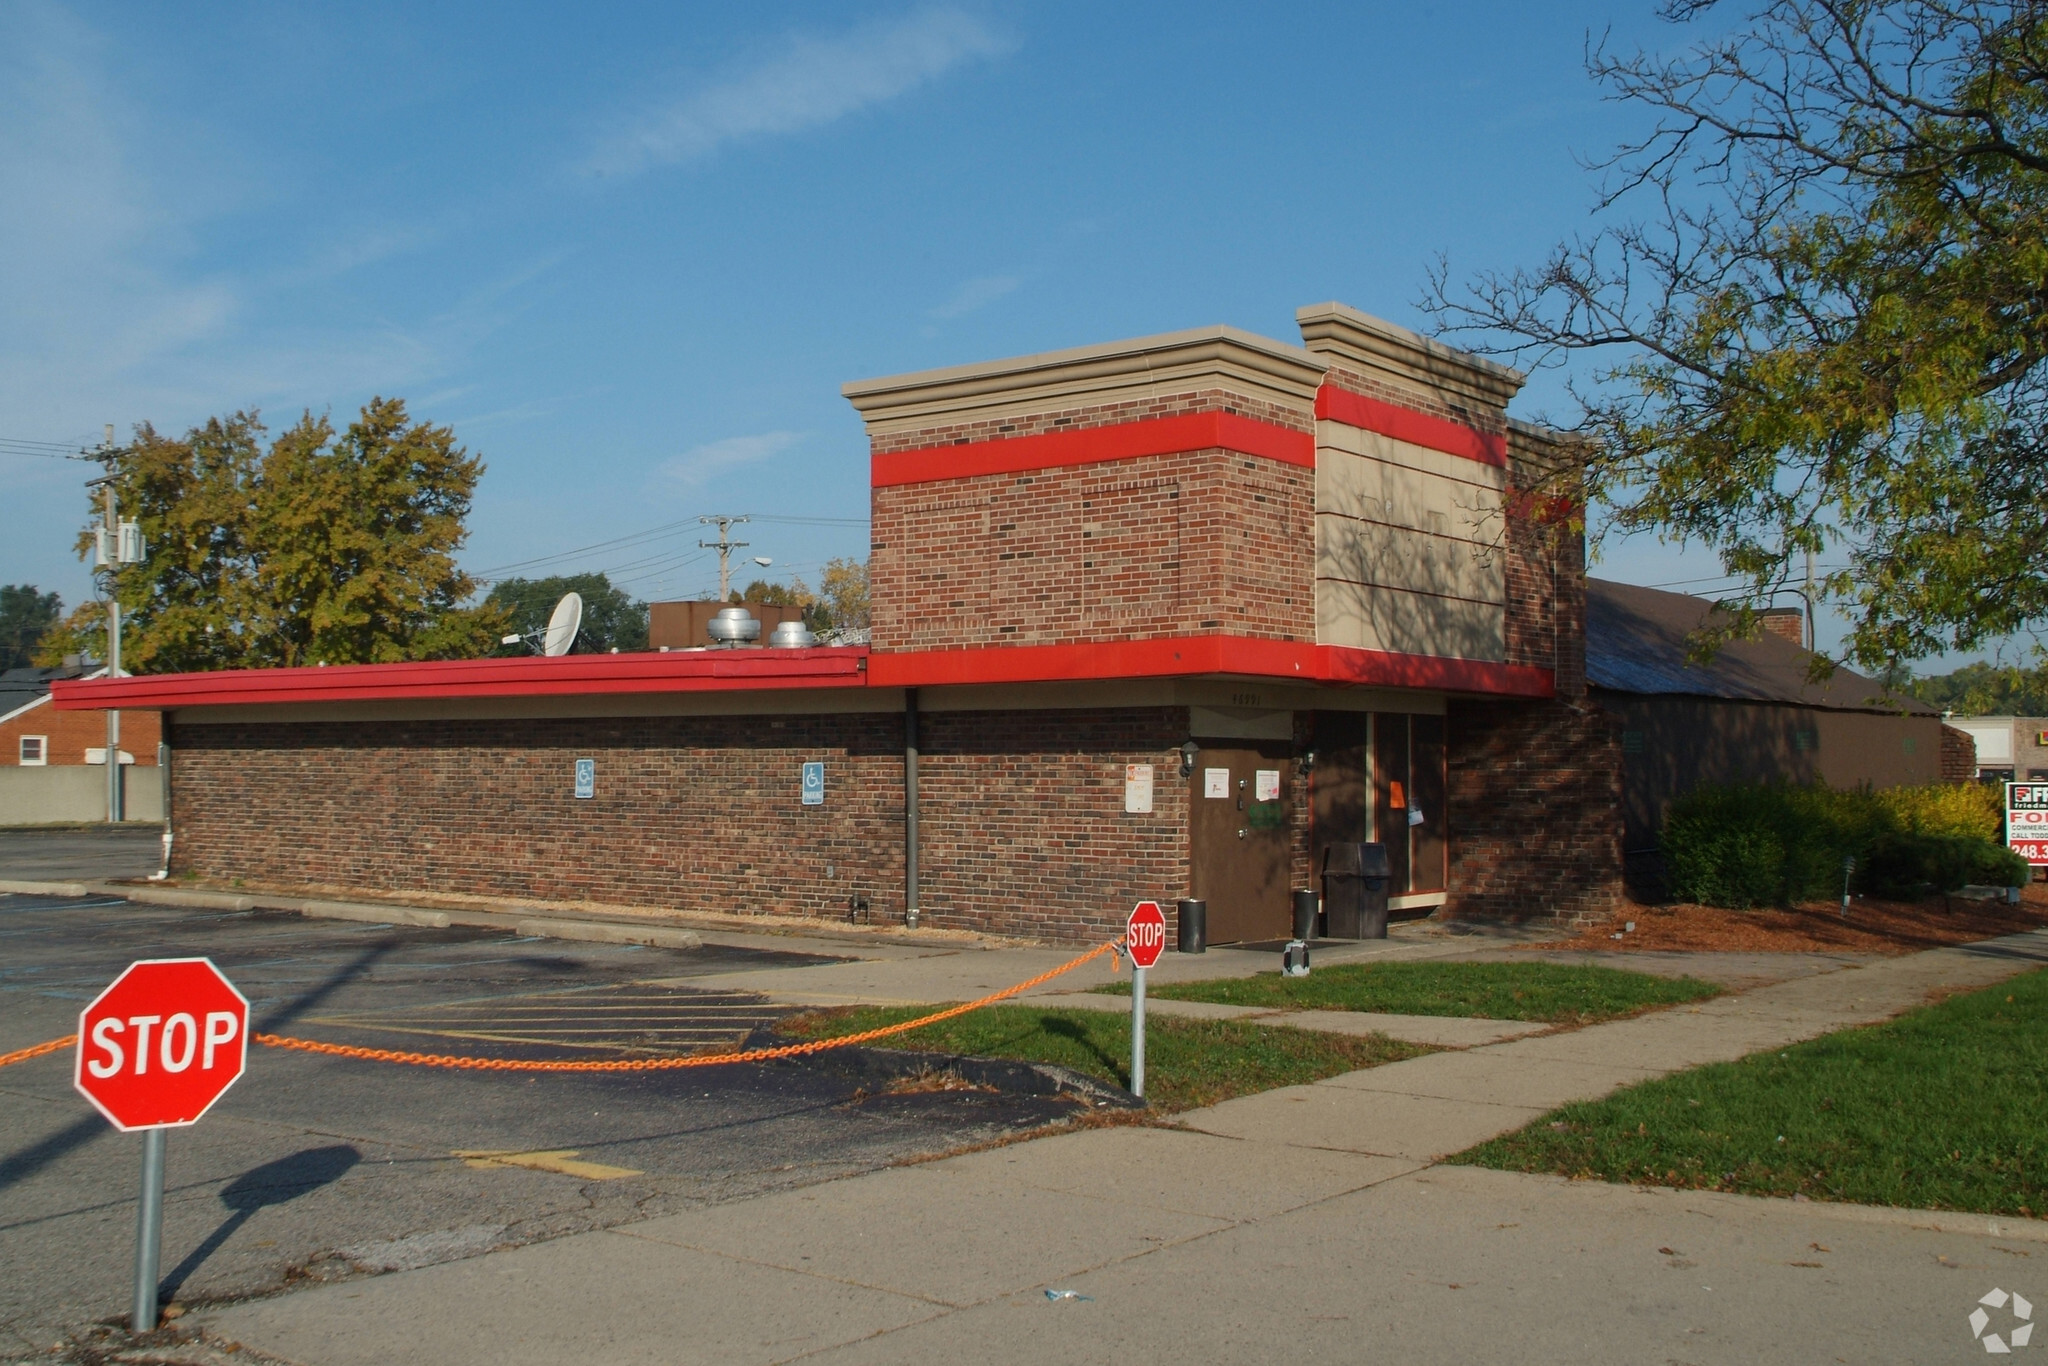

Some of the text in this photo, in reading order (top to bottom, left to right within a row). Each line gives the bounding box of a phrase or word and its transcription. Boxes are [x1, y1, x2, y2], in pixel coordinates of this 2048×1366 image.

[2010, 812, 2048, 823] FO
[1130, 922, 1163, 947] STOP
[87, 1011, 239, 1079] STOP
